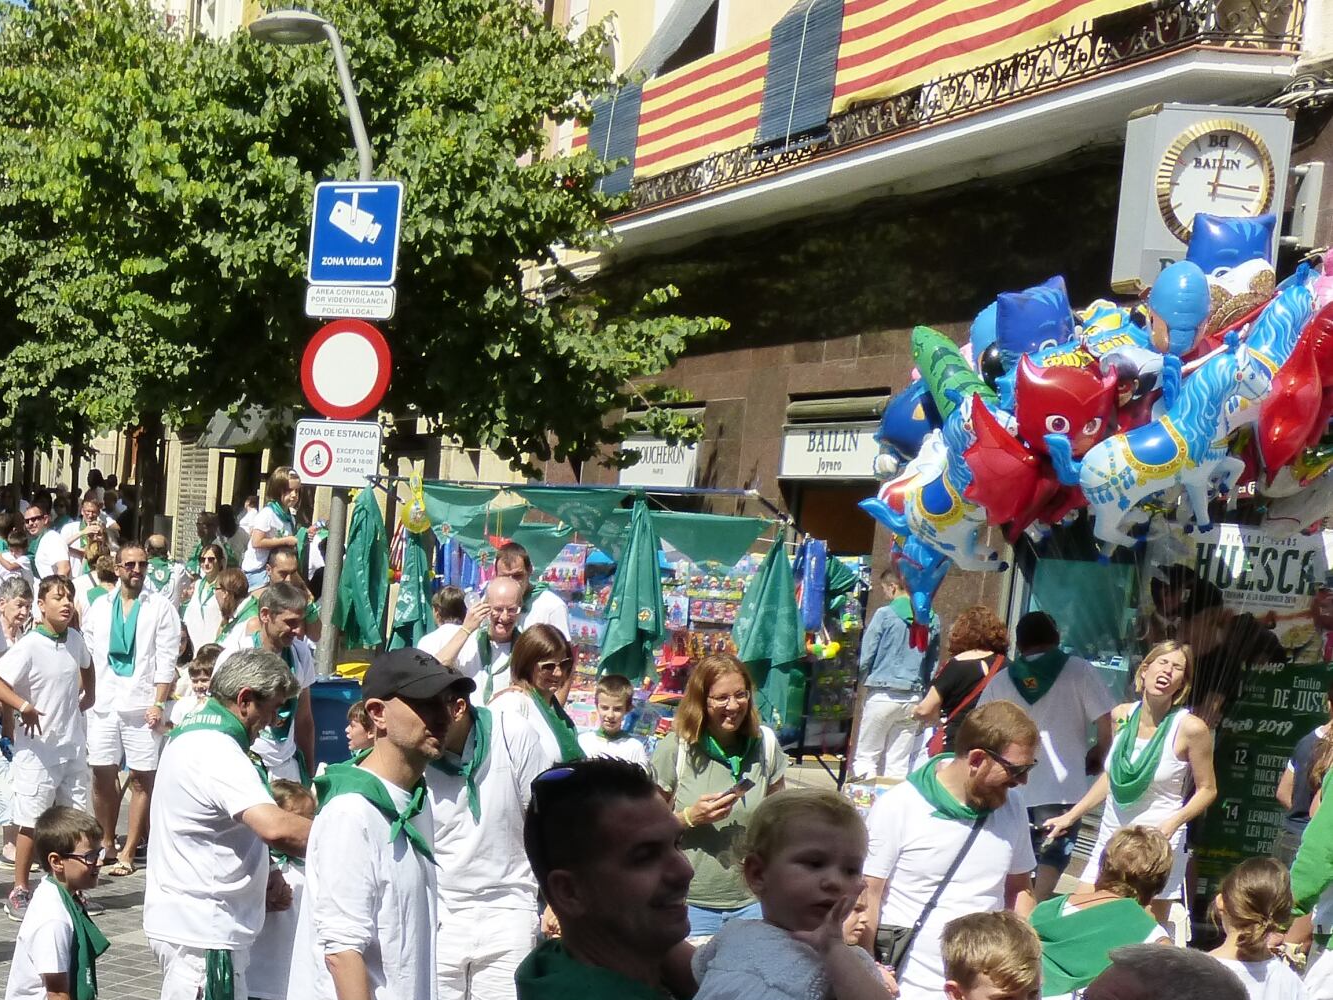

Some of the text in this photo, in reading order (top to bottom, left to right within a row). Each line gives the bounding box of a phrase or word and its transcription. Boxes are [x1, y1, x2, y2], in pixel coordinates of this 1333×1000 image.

[1193, 157, 1241, 170] BAILIN
[321, 257, 383, 266] ZONA VIGILADA
[336, 288, 385, 297] CONTROLADA
[327, 297, 388, 305] VIDEOVIGILANCIA
[352, 308, 375, 316] LOCAL
[299, 427, 377, 439] ZONA DE ESTANCIA
[807, 430, 860, 453] BAILIN
[817, 457, 842, 474] Joyero
[1194, 543, 1315, 596] HUESCA
[1292, 675, 1322, 690] Emilio
[1272, 688, 1291, 709] DE
[1256, 720, 1293, 737] 2019
[1235, 749, 1248, 765] 12
[1225, 805, 1239, 820] 14
